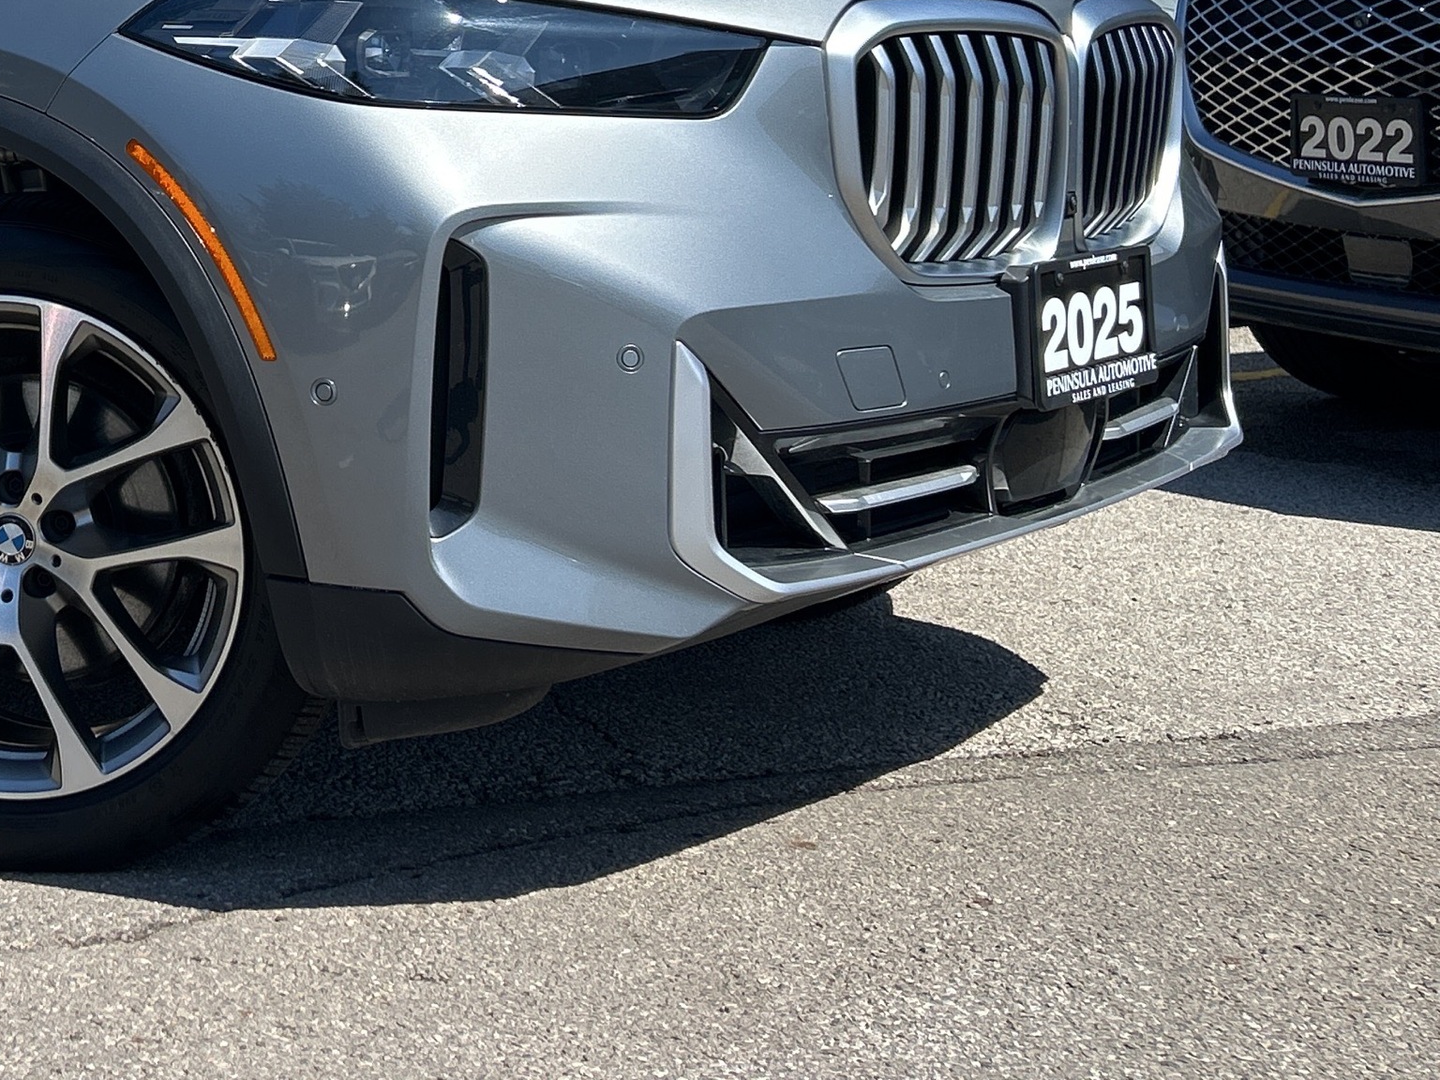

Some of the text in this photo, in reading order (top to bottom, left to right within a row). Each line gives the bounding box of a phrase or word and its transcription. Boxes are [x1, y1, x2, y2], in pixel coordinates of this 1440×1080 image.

[1300, 115, 1414, 164] 2022
[1293, 158, 1416, 179] PENINSULA AUTOMOTIVE
[1318, 172, 1388, 184] SALES AND LEASING
[1043, 282, 1144, 372] 2025
[1046, 352, 1157, 397] PENINSULA AUTOMOTIVE
[1071, 377, 1136, 404] SALES AND LEASING
